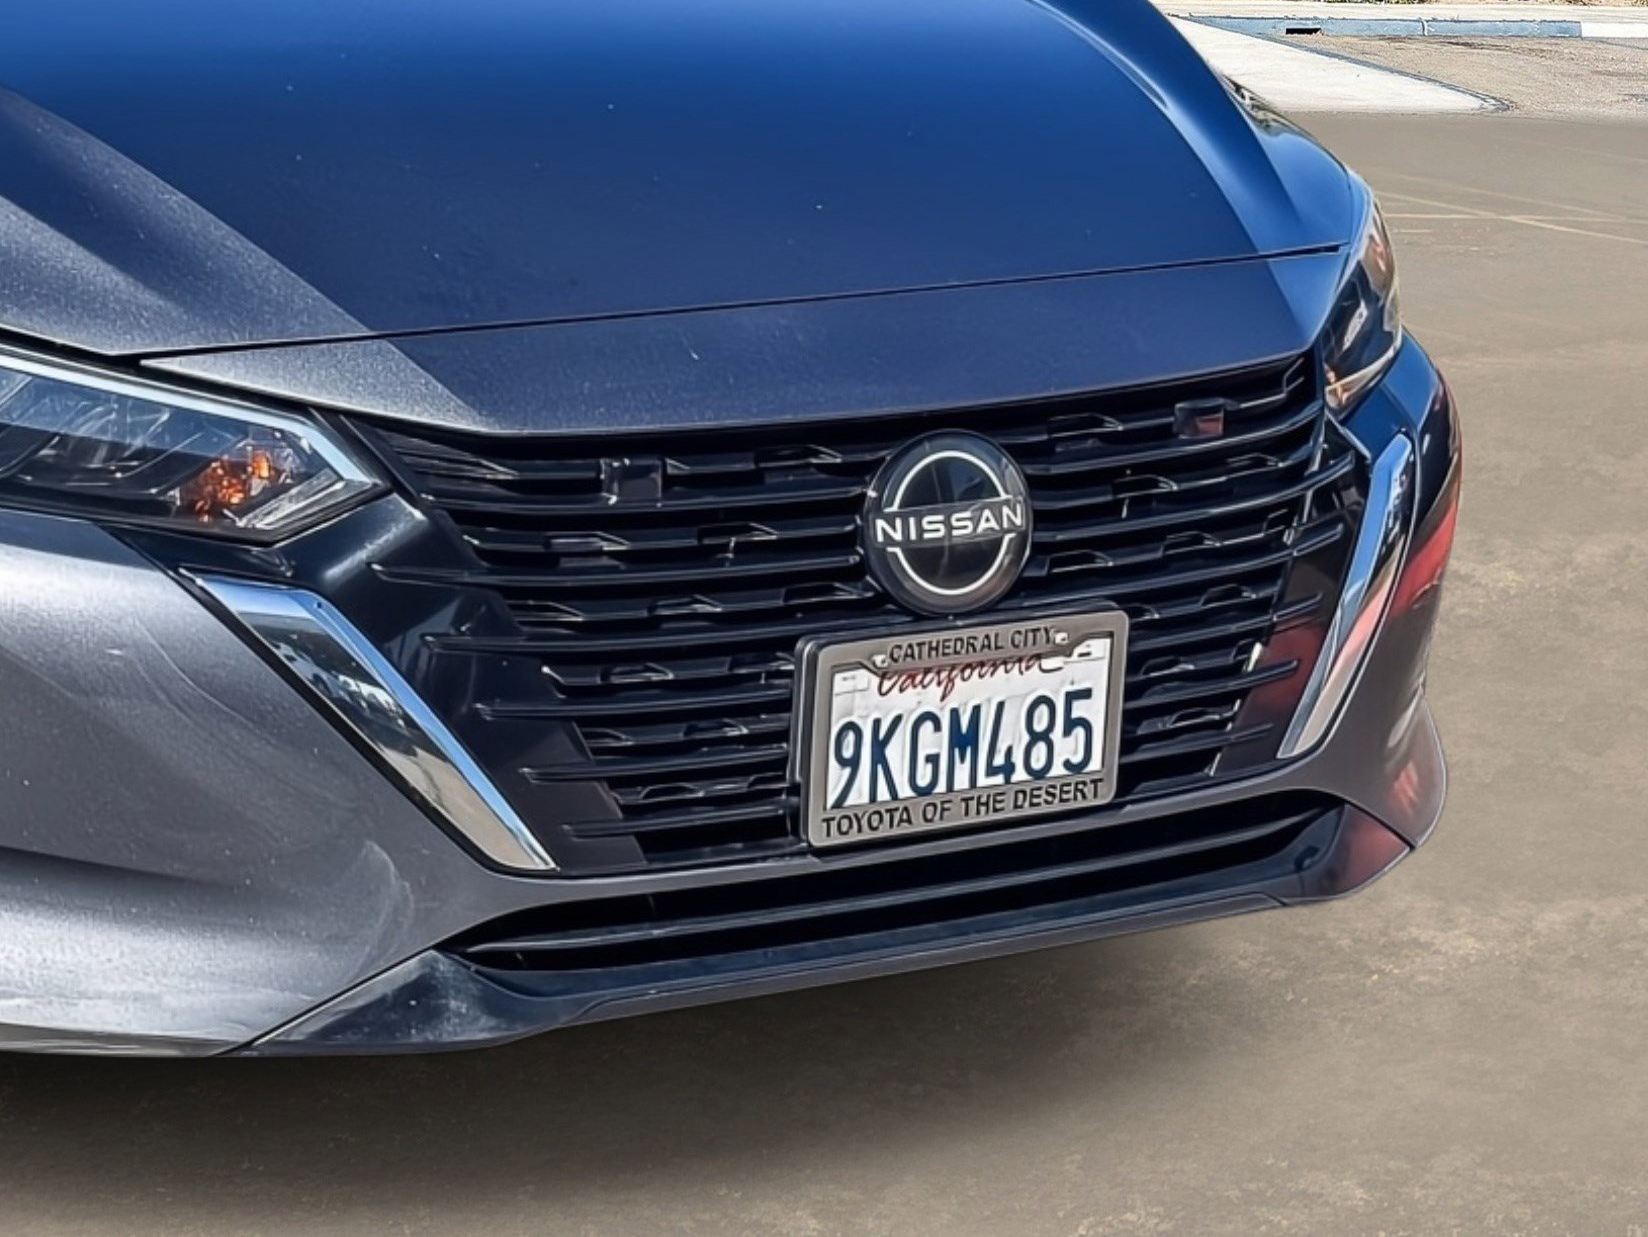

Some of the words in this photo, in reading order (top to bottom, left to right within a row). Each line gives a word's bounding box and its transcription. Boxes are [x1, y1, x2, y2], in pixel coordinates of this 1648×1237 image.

[875, 504, 1022, 543] NISSAN
[889, 633, 1002, 663] CATHEDRAL
[1010, 626, 1054, 648] CITY
[878, 652, 1064, 702] California
[831, 687, 1093, 810] 9KGM485
[822, 807, 912, 838] TOYOTA
[922, 799, 953, 823] OF
[960, 792, 1006, 817] THE
[1013, 778, 1104, 810] DESERT
